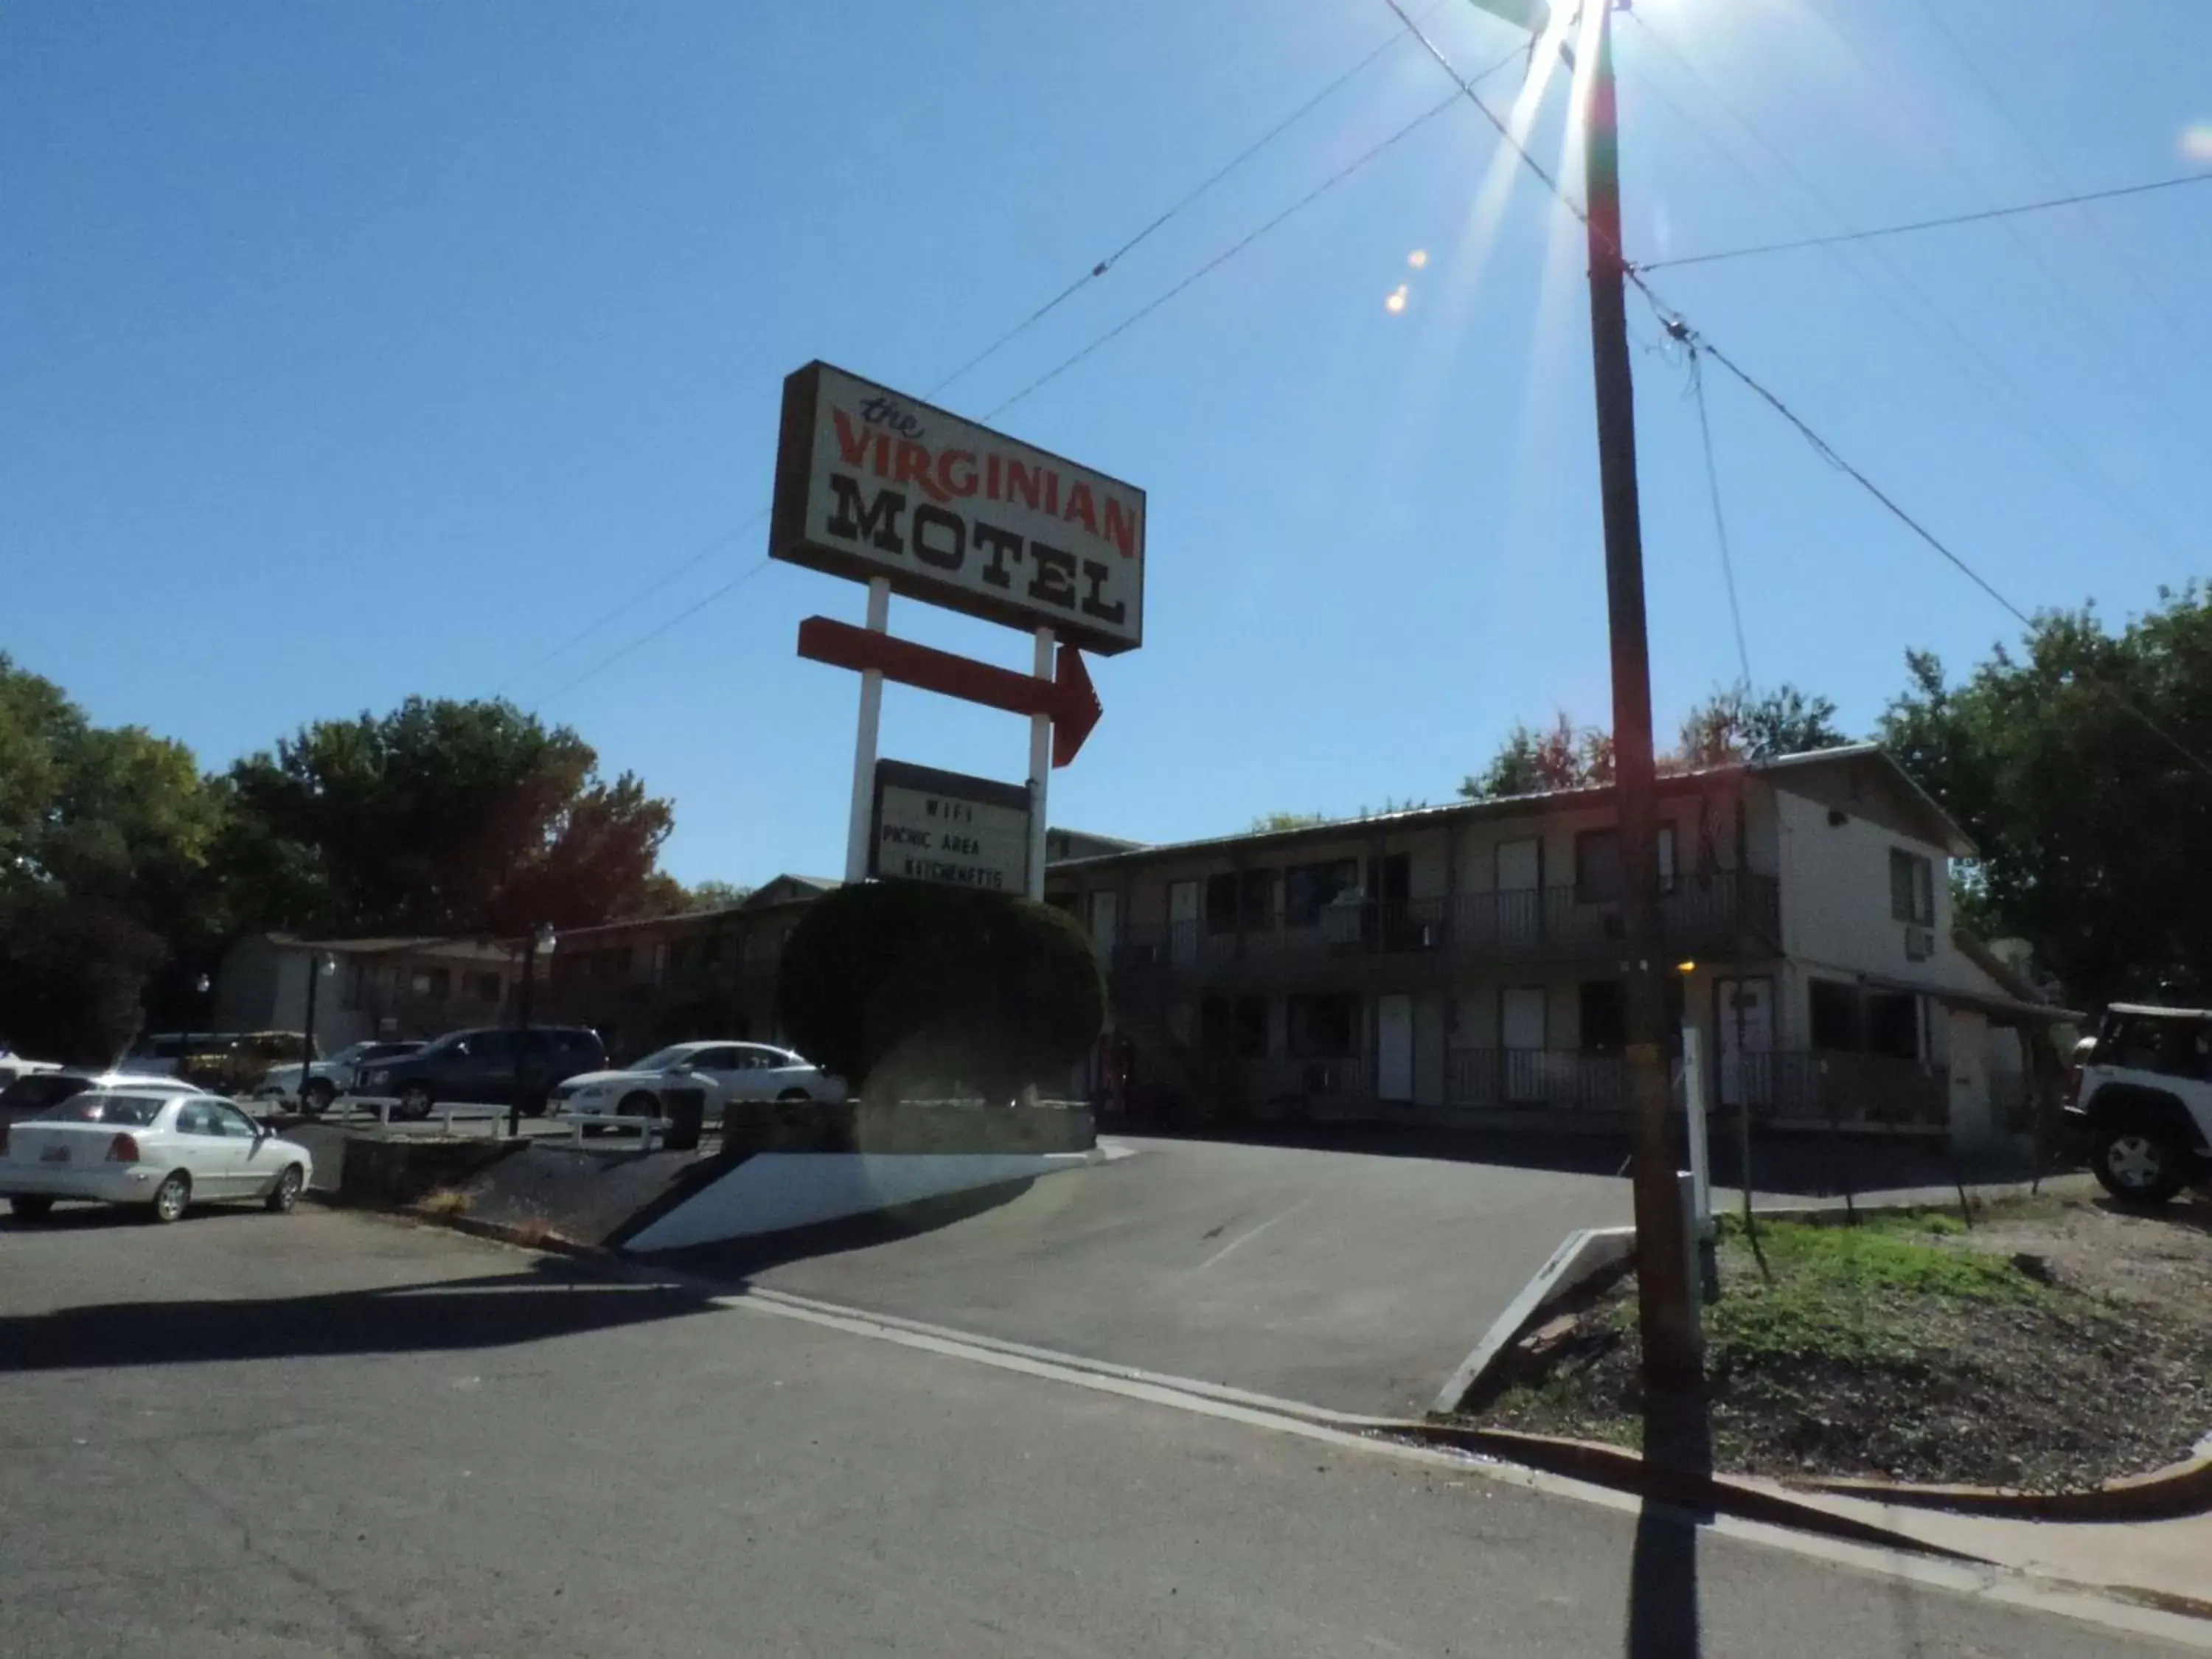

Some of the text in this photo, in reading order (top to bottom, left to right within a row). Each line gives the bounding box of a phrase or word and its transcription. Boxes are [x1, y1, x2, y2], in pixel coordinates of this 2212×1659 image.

[860, 397, 925, 439] the
[832, 406, 1139, 559] VIRGINIAN
[827, 473, 1125, 625] MOTEL
[883, 824, 979, 855] PICNIC AREA
